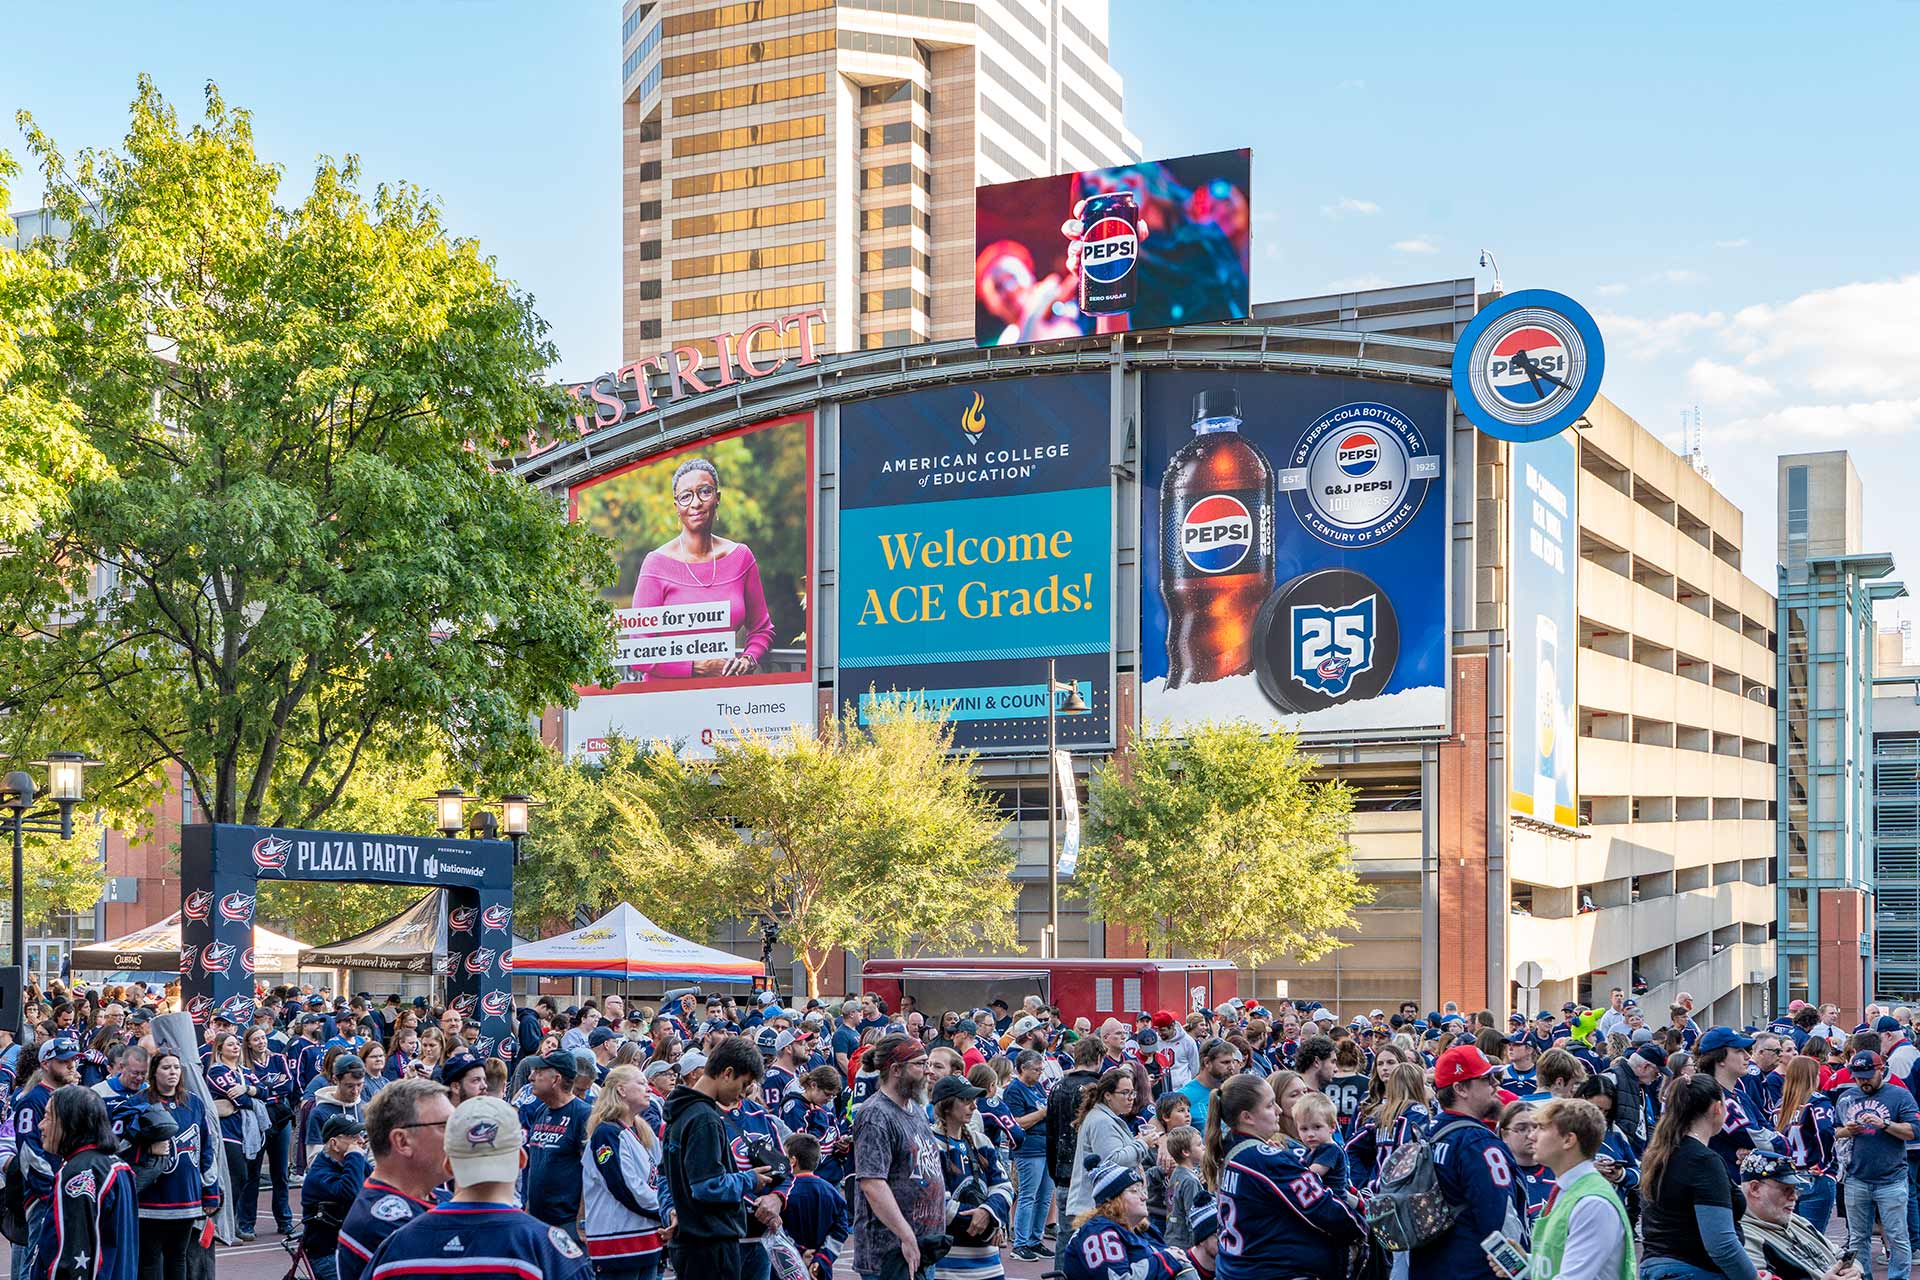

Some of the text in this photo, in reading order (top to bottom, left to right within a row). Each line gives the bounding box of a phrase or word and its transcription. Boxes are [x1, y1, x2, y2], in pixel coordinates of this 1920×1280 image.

[1084, 241, 1134, 260] PEPSI
[1295, 443, 1309, 464] G&J
[1362, 407, 1408, 435] BOTTLERS,
[1406, 433, 1420, 453] INC.
[881, 443, 1070, 473] AMERICAN COLLEGE
[1339, 449, 1378, 461] PEPSI
[1416, 463, 1436, 472] 1925
[918, 475, 931, 487] of
[1325, 481, 1393, 495] G&J PEPSI
[1329, 498, 1351, 512] 100
[1304, 503, 1412, 542] A CENTURY OF SERVICE
[1185, 524, 1250, 544] PEPSI
[878, 528, 1073, 571] Welcome
[857, 573, 1093, 626] ACE Grads!
[611, 608, 725, 630] hoice for your
[634, 644, 667, 659] care
[669, 640, 683, 656] is
[686, 639, 729, 655] clear.
[1302, 615, 1365, 670] 25
[716, 701, 786, 717] The James
[985, 698, 996, 709] &
[297, 841, 420, 875] PLAZA PARTY
[765, 1088, 780, 1105] 13
[1324, 1084, 1358, 1116] 86
[1483, 1145, 1512, 1187] 8
[1289, 1170, 1324, 1208] 23
[1082, 1229, 1125, 1270] 86
